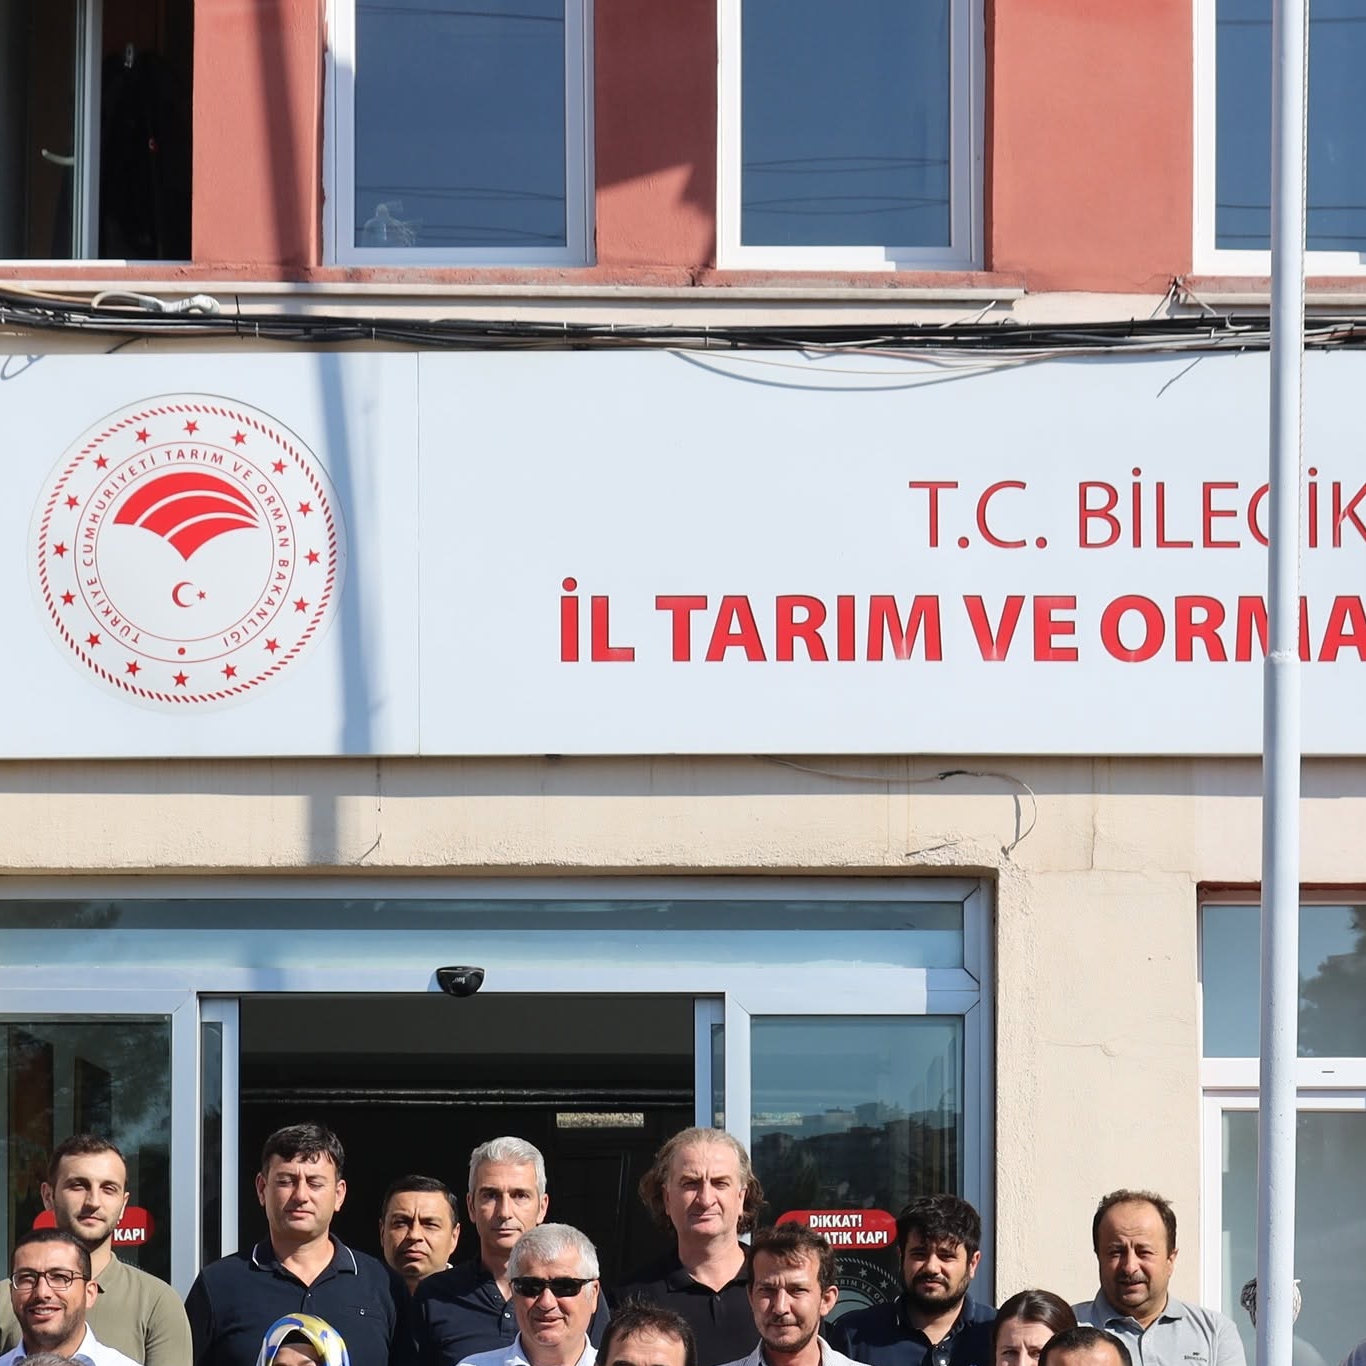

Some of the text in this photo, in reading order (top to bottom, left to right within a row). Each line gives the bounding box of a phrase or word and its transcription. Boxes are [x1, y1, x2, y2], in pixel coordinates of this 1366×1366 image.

[909, 480, 1047, 549] T.C.
[82, 448, 290, 648] TÜRKİYE CUMHURİYETİ TARIM VE ORMAN BAKANLIĞI
[560, 577, 635, 663] İL
[654, 594, 943, 663] TARIM
[963, 594, 1079, 663] VE
[114, 1228, 145, 1241] KAPI
[856, 1231, 888, 1244] KAPI
[833, 1279, 858, 1287] ARIM
